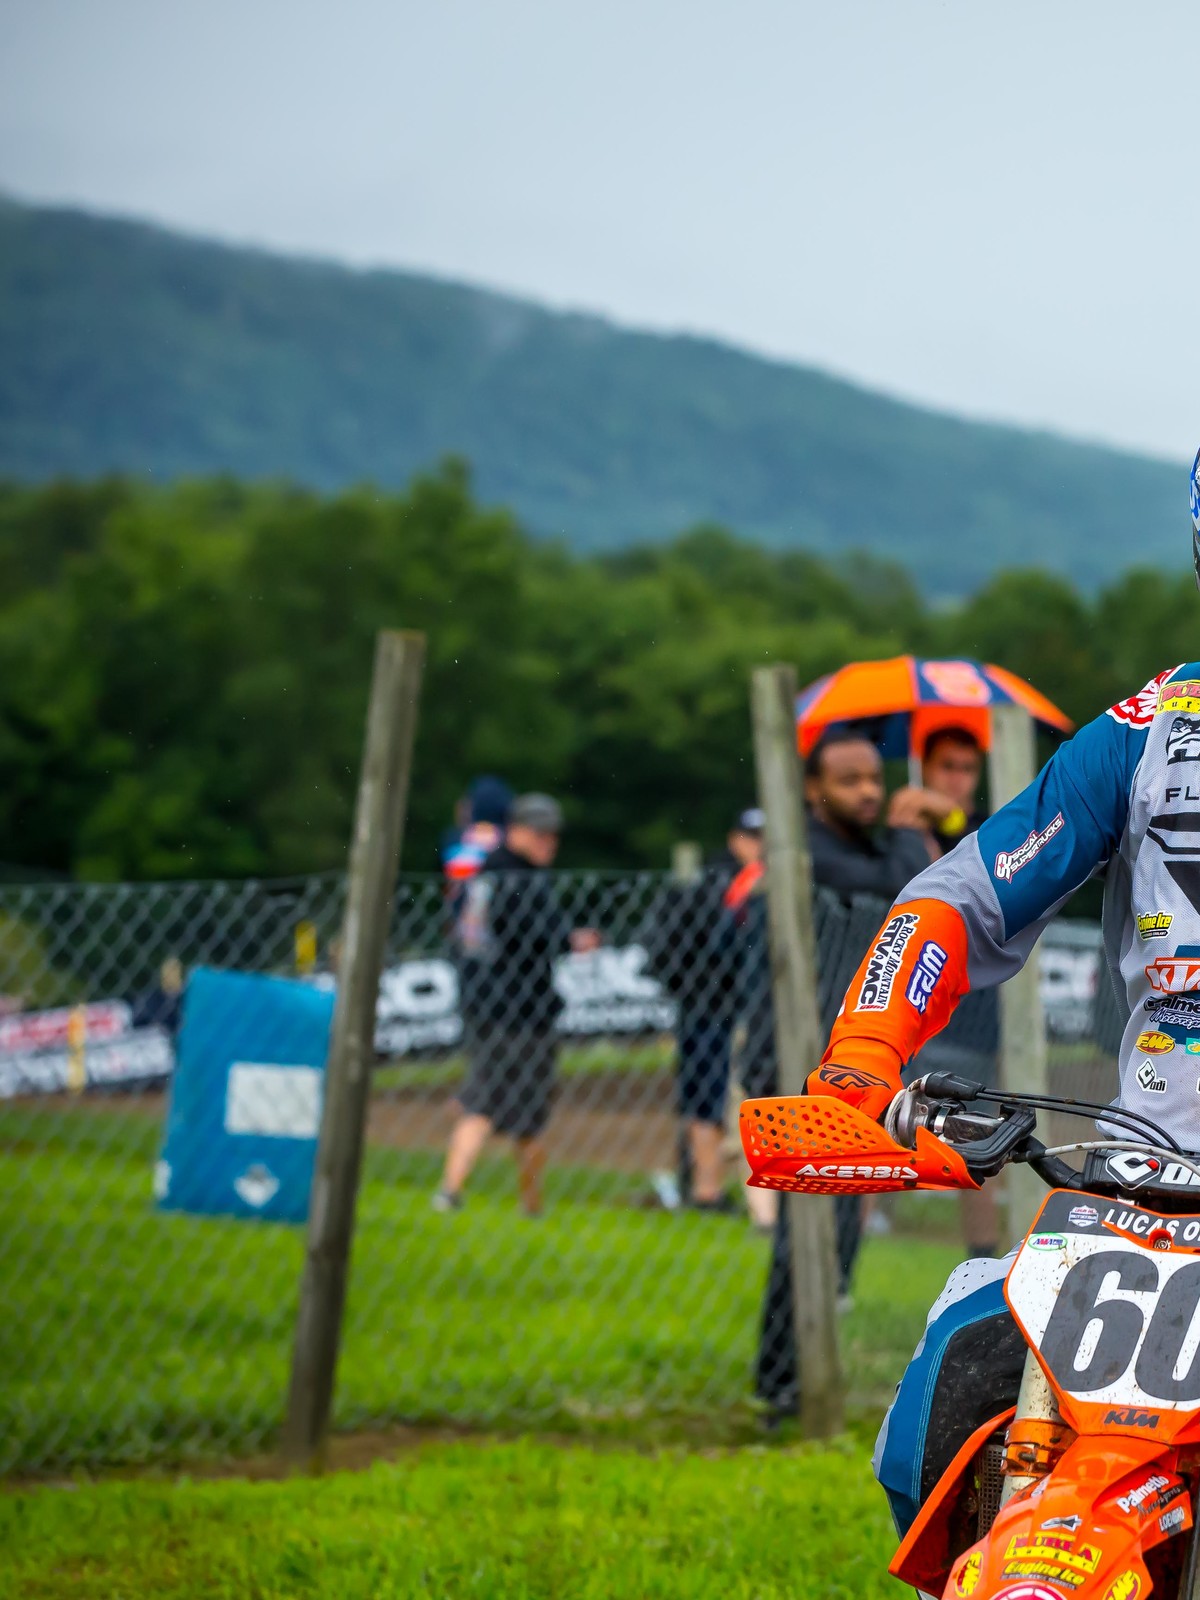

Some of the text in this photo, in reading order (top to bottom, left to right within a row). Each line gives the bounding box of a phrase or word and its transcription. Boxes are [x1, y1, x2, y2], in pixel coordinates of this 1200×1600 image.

[1156, 912, 1171, 928] Ice
[877, 925, 914, 1006] ROCKY MOUNTAIN
[907, 942, 948, 1013] WPS
[1137, 1035, 1174, 1050] FMF
[796, 1164, 918, 1179] ACERBIS
[1101, 1208, 1179, 1239] LUCAS
[1103, 1407, 1161, 1429] KTM
[1116, 1475, 1170, 1514] Palmetto
[1004, 1560, 1062, 1577] Engine
